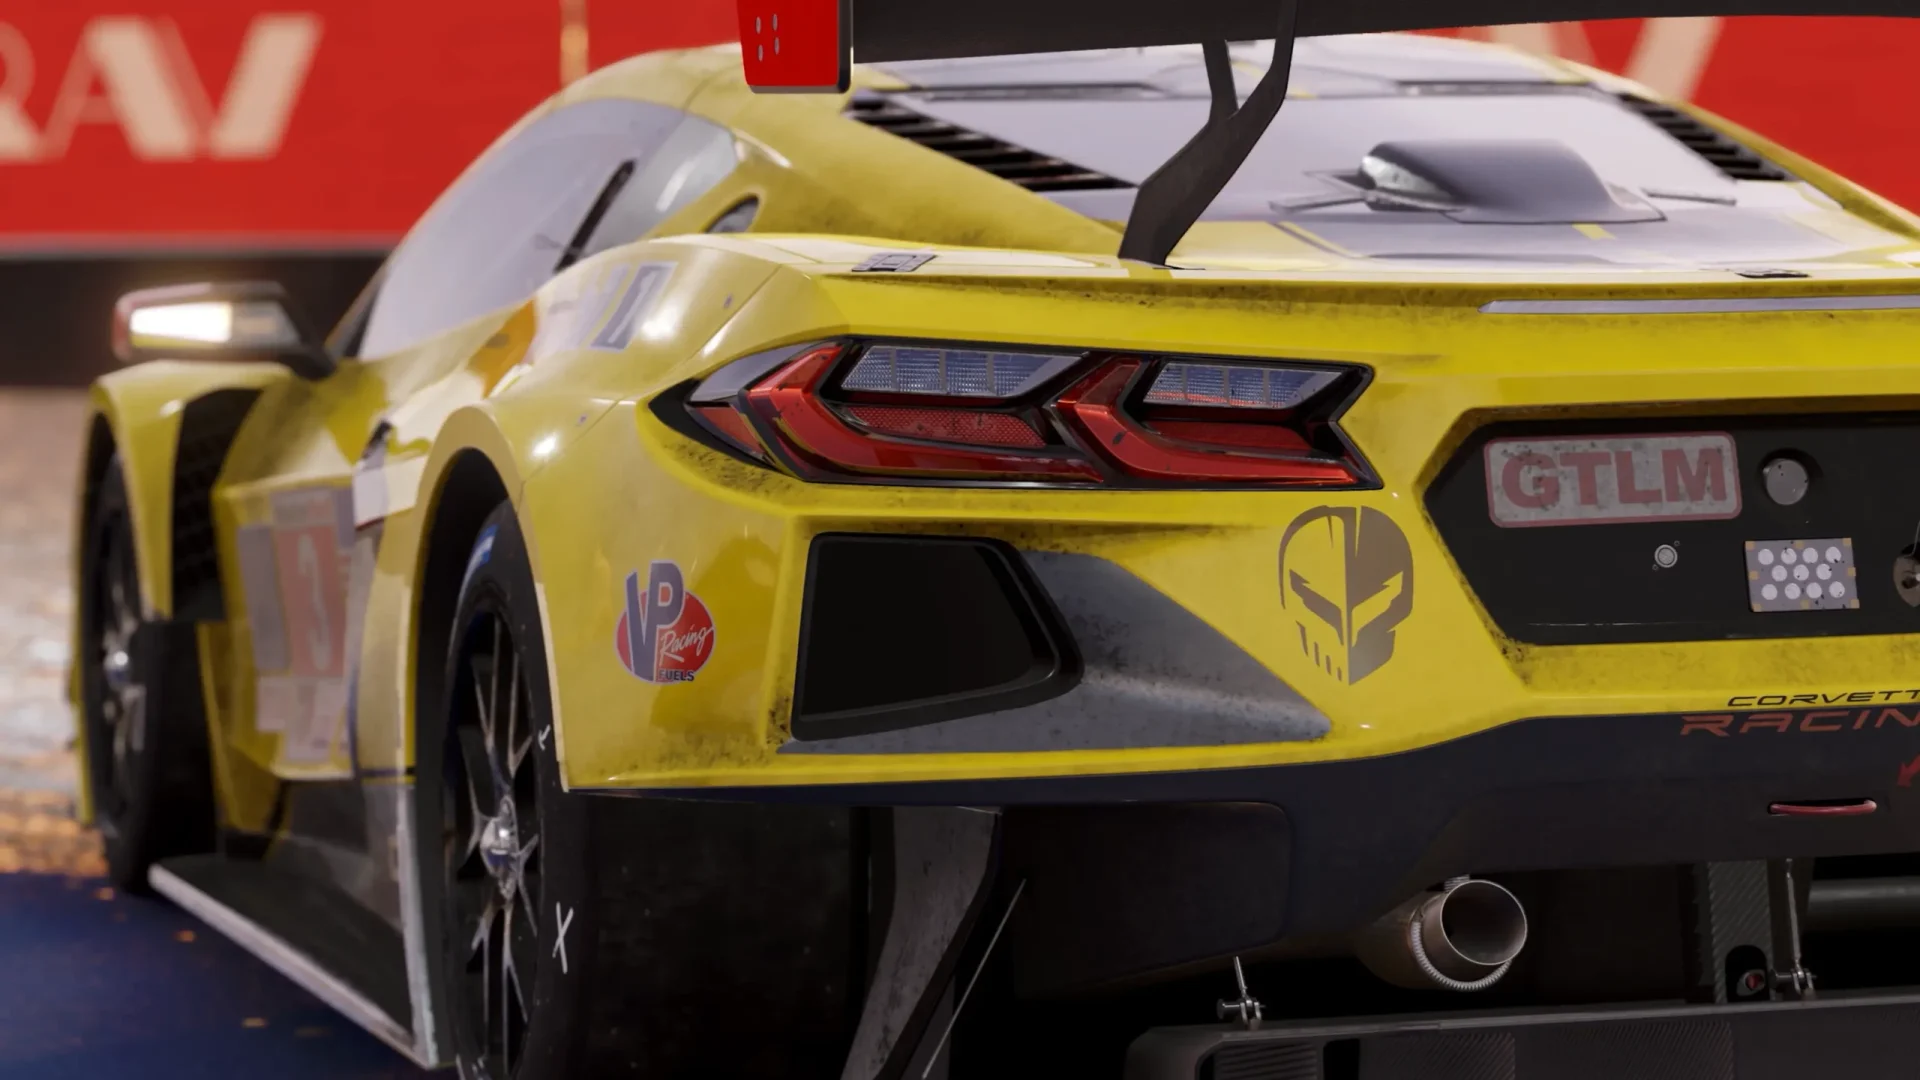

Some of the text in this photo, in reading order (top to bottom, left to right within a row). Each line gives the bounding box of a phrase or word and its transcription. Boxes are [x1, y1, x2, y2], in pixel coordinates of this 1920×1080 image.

[1501, 447, 1729, 511] GTLM
[624, 560, 685, 683] VP
[658, 624, 716, 667] Racing
[658, 669, 695, 682] FUELS
